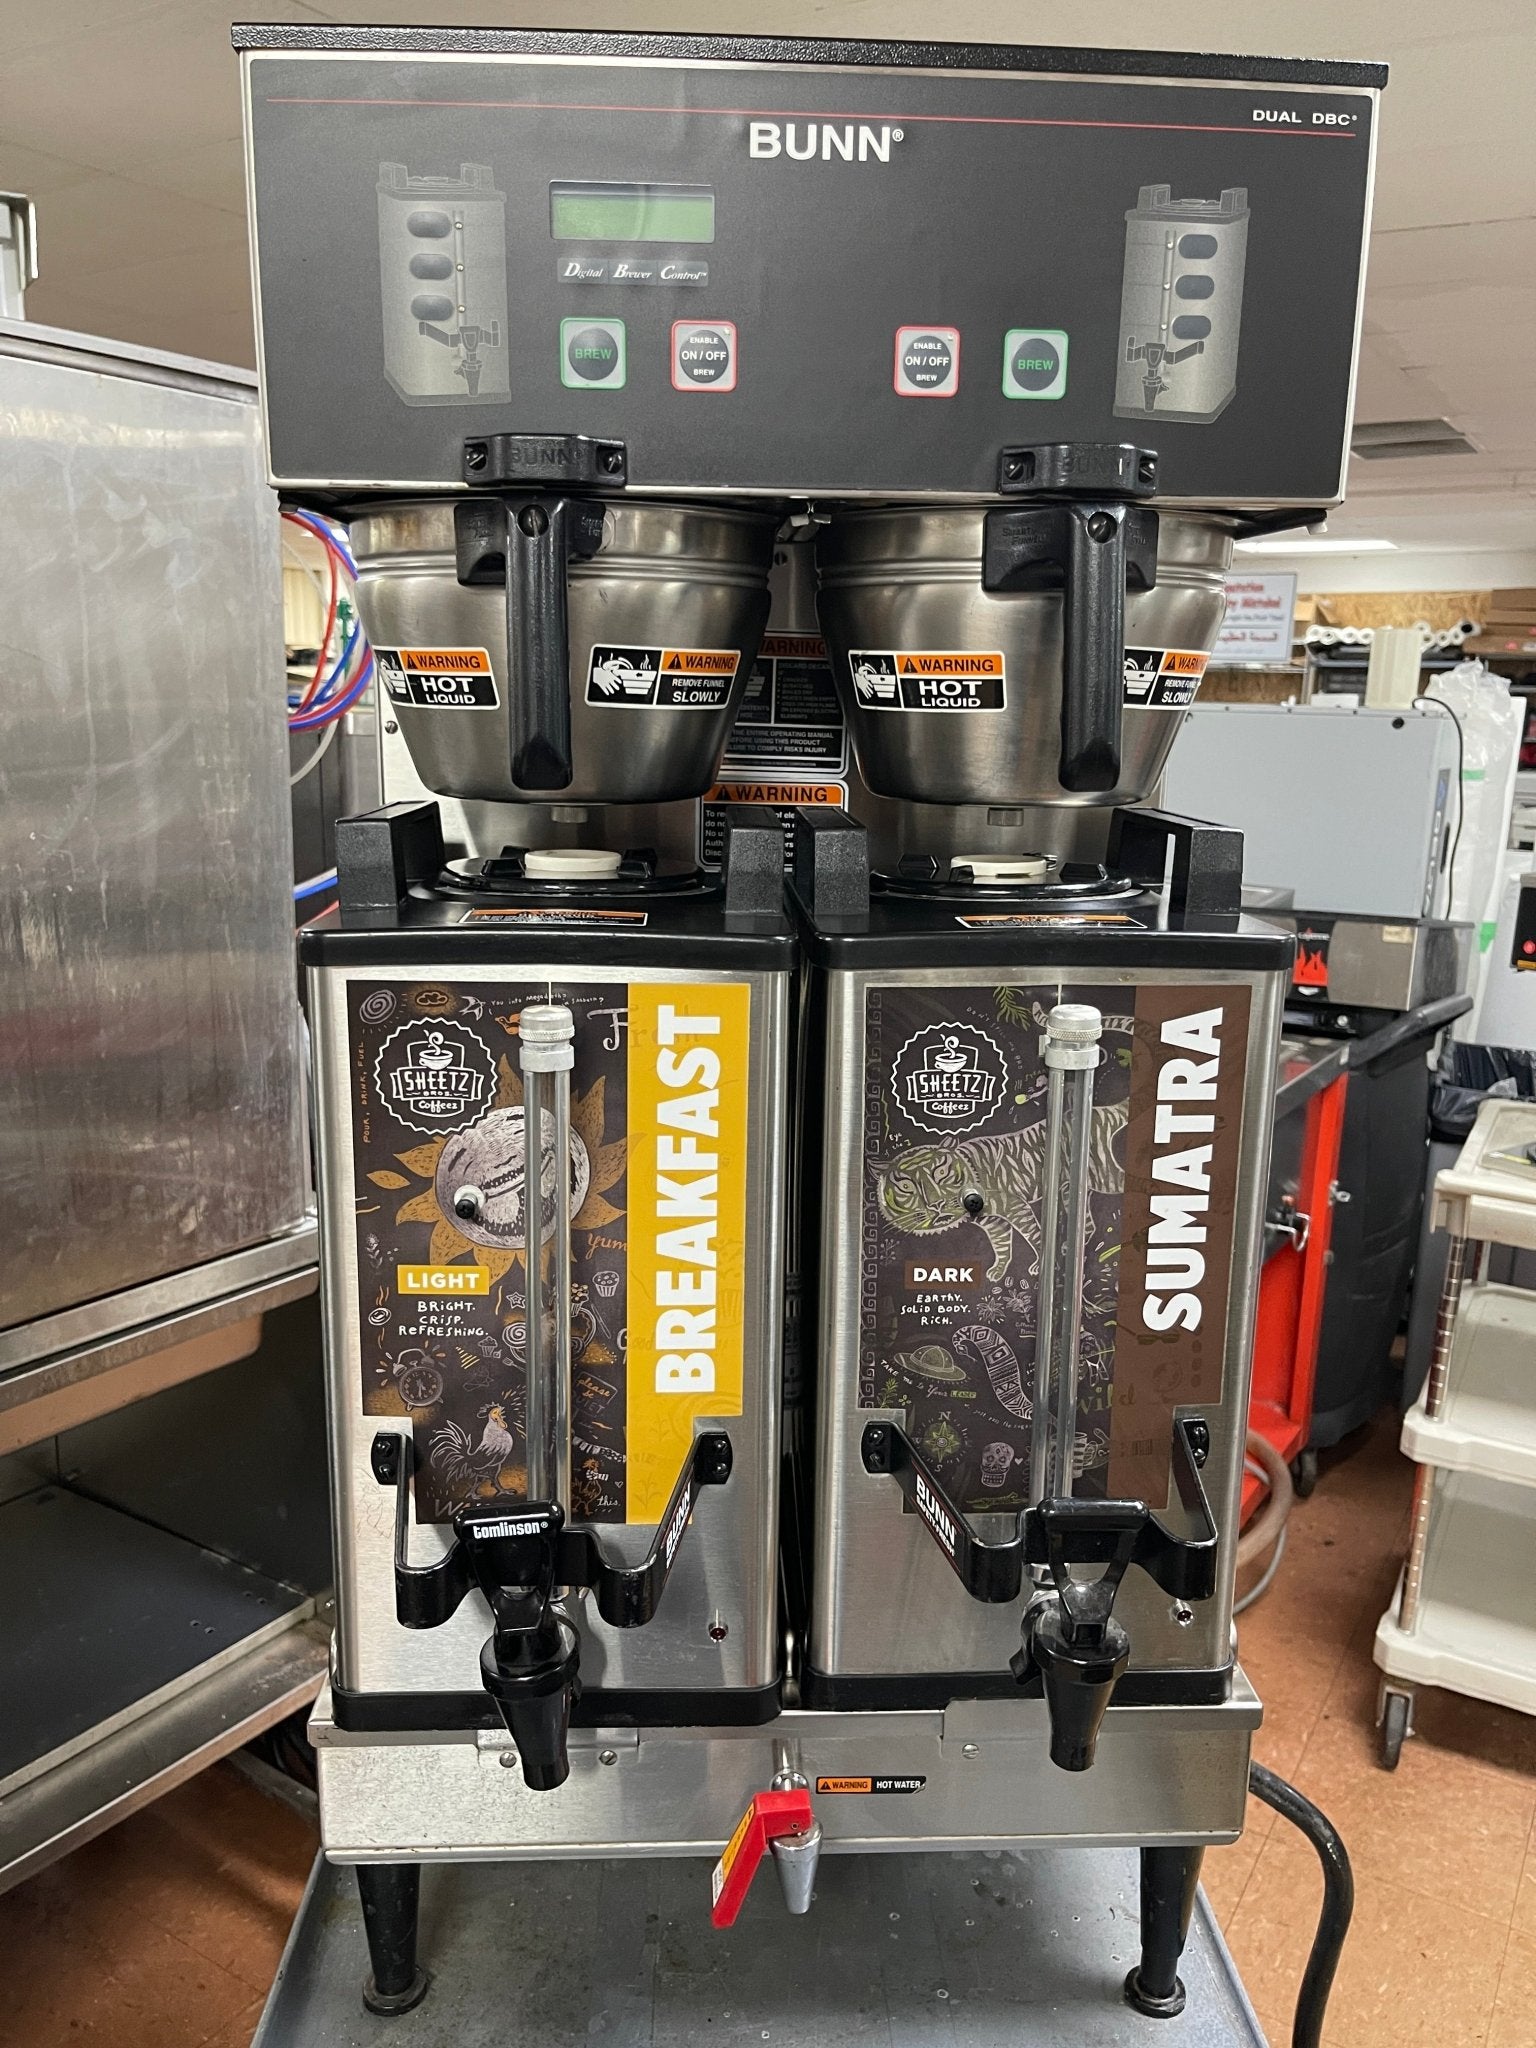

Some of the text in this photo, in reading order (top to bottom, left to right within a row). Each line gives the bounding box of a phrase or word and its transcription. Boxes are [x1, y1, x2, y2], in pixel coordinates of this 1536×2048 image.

[1252, 109, 1302, 123] DUAL
[563, 262, 604, 279] Digital
[612, 263, 652, 279] Brewer
[689, 336, 719, 345] ENABLE
[913, 342, 942, 350] ENABLE
[574, 349, 612, 360] BREW
[1018, 359, 1054, 371] BREW
[693, 369, 715, 377] BREW
[915, 374, 938, 382] BREW
[761, 639, 825, 655] ARNING
[416, 655, 481, 669] WARNING
[685, 655, 735, 670] WARNING
[918, 659, 994, 672] WARNING
[420, 676, 474, 693] HOT
[671, 678, 702, 687] REMOVE
[918, 680, 983, 696] HOT
[425, 693, 476, 705] LIQUID
[672, 691, 721, 703] SLOWLY
[921, 697, 981, 708] LIQUID
[735, 786, 828, 802] WARNING
[403, 1070, 470, 1092] SHEETZ
[919, 1073, 983, 1094] SHEETZ
[418, 1100, 459, 1113] Coffeez
[931, 1102, 970, 1114] Coffeez
[1142, 1006, 1223, 1332] SUMATRA
[655, 1004, 721, 1393] BREAKFAST
[407, 1272, 480, 1289] LIGHT
[913, 1267, 974, 1282] DARK
[665, 1480, 691, 1559] BUNN
[831, 1781, 868, 1789] WARNING
[876, 1780, 921, 1789] HOT WATER
